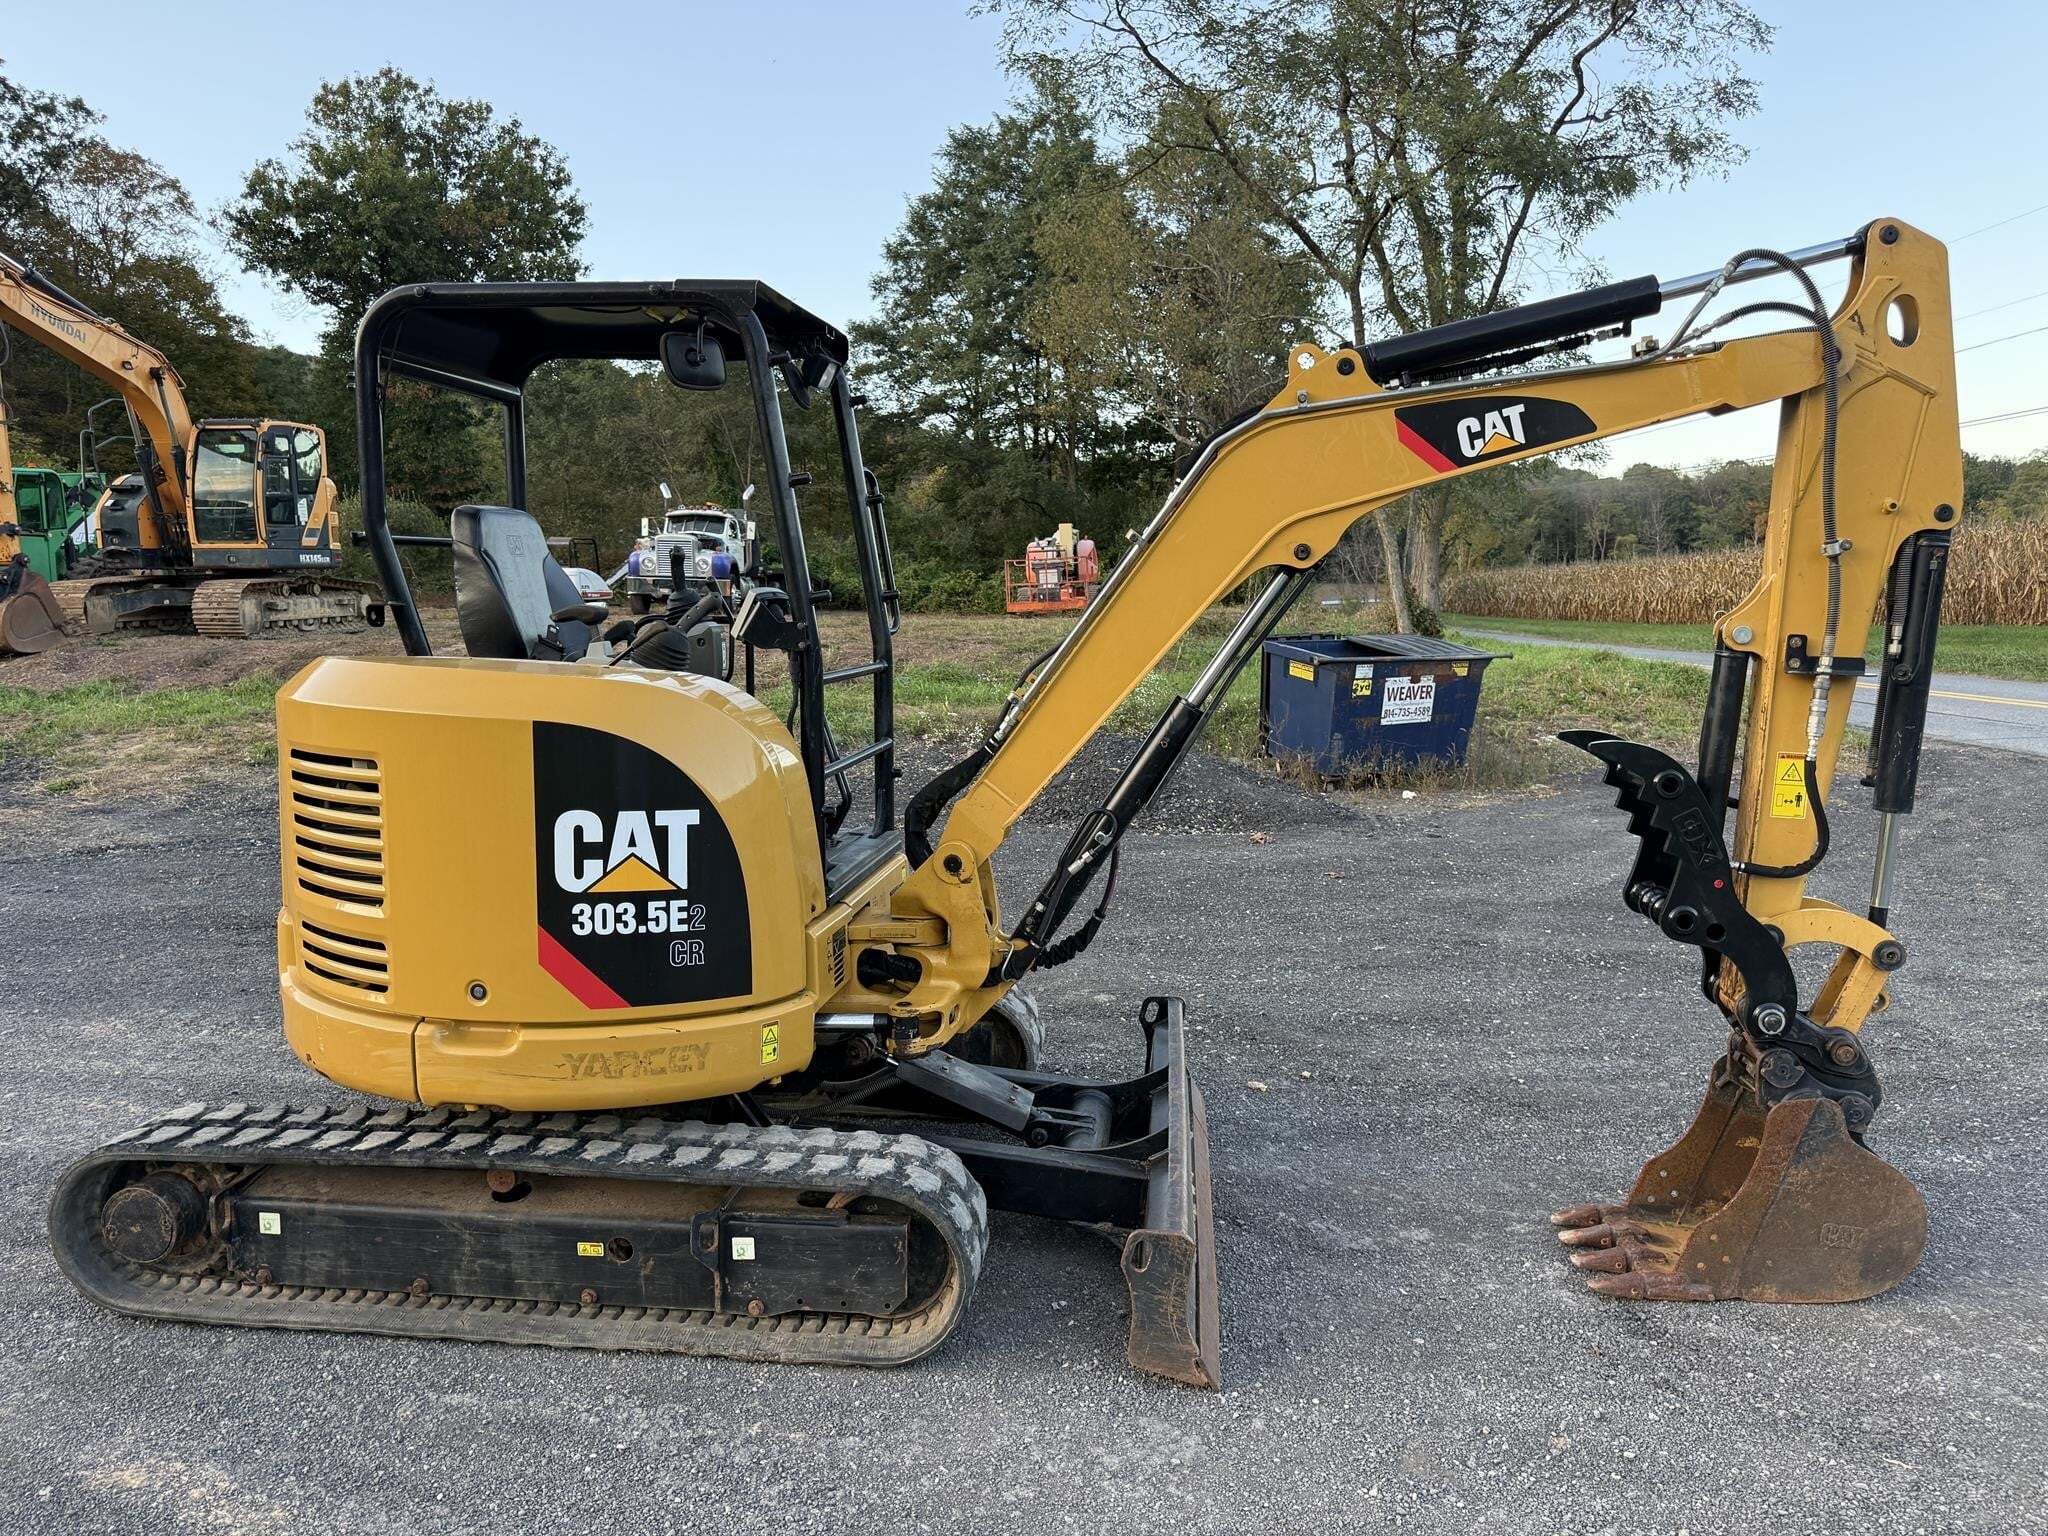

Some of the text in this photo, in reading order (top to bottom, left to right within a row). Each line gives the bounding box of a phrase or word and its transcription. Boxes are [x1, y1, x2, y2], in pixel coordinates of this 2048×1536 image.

[1457, 404, 1525, 457] CAT
[1387, 685, 1432, 702] WEAVER
[1384, 706, 1430, 719] 814-735-4589
[554, 809, 700, 893] CAT
[571, 900, 706, 936] 303.5E2
[669, 940, 705, 966] CR
